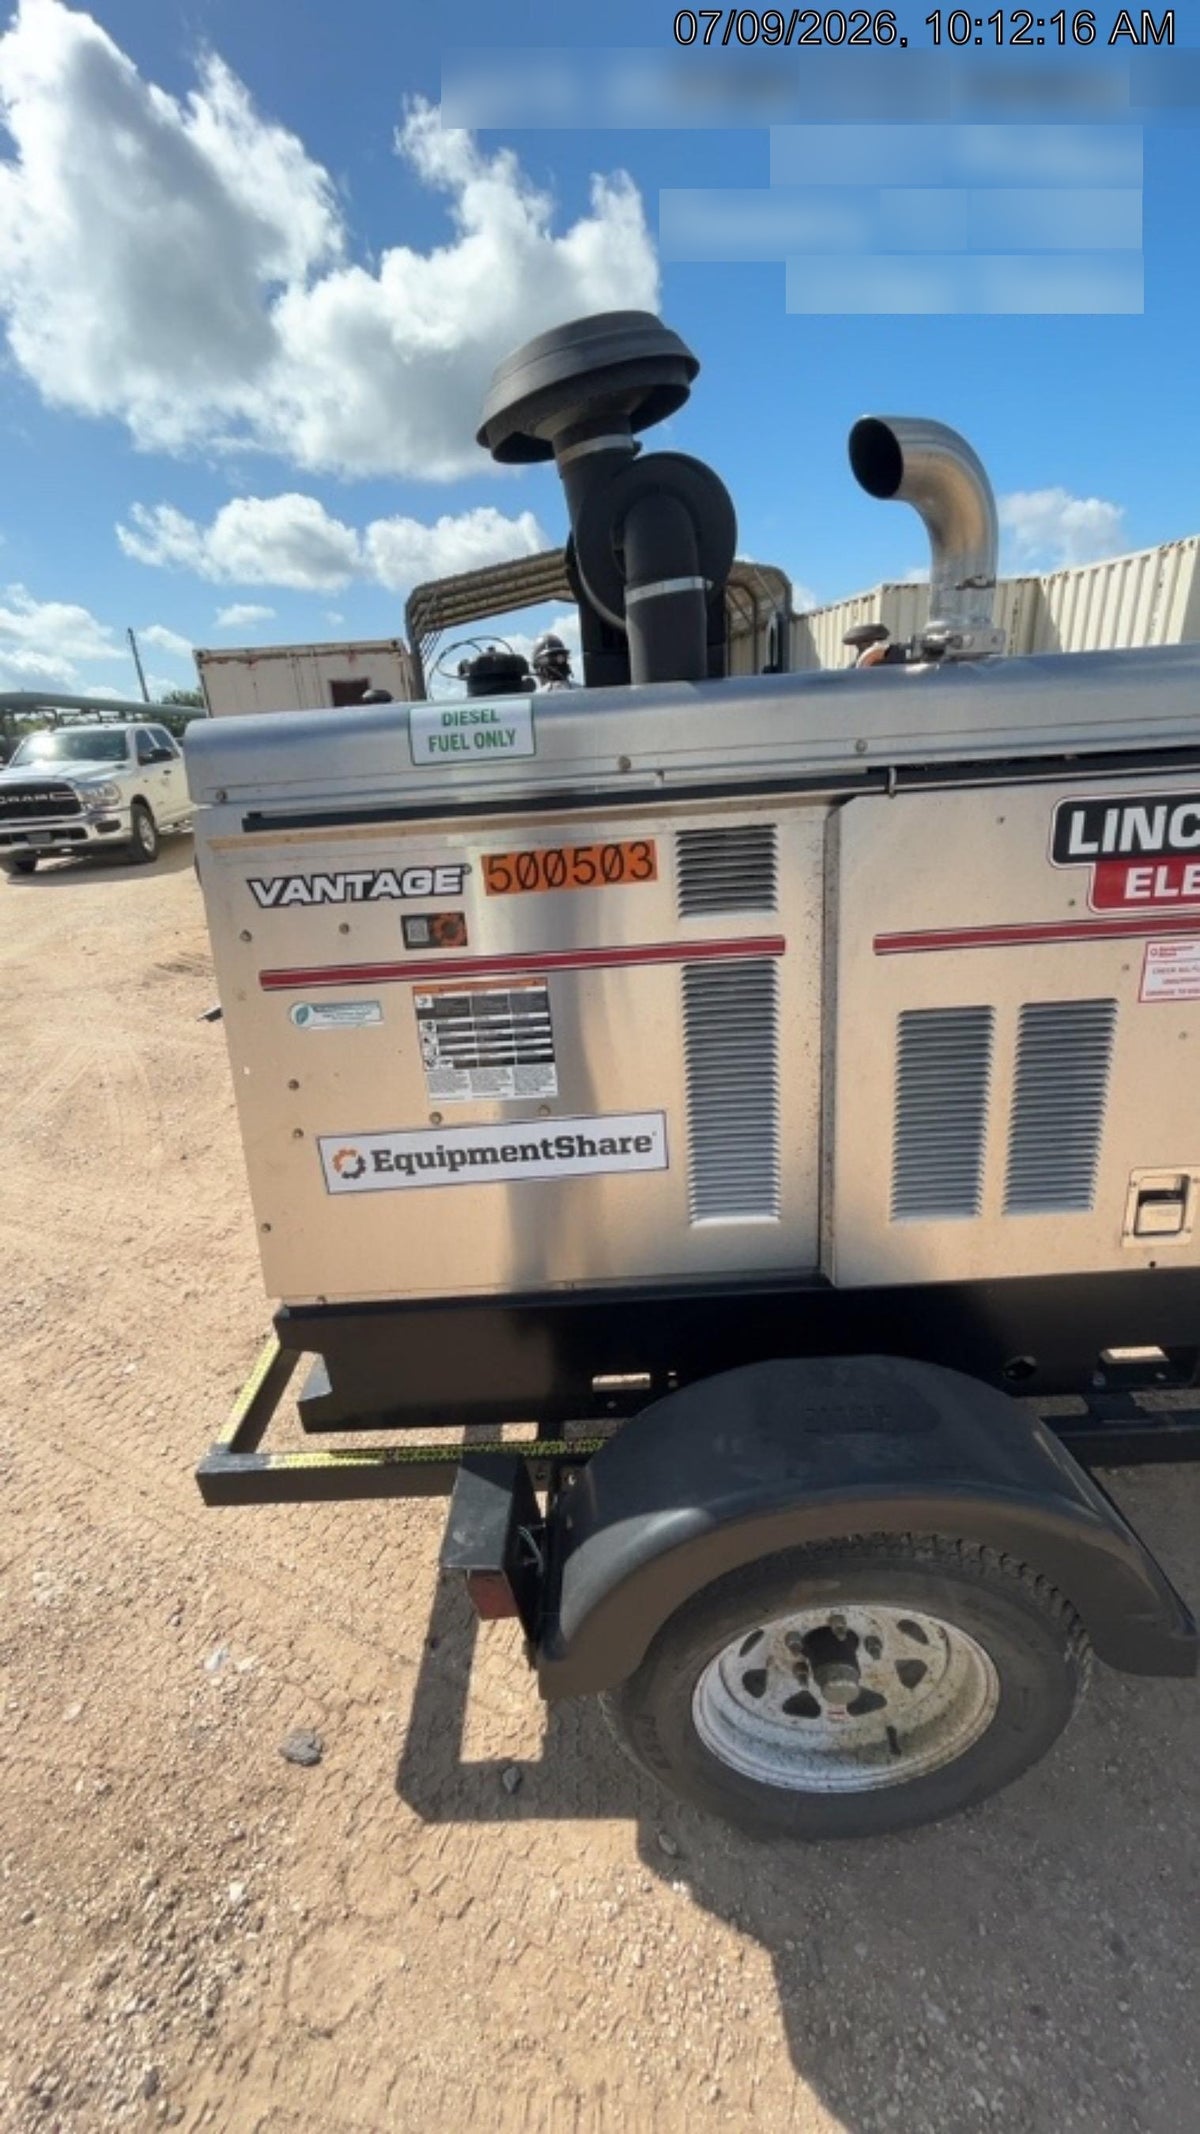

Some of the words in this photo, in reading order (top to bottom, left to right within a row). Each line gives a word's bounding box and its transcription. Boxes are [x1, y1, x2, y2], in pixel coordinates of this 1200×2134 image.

[441, 708, 500, 727] DIESEL
[428, 733, 470, 753] FUEL
[473, 727, 516, 750] ONLY
[247, 864, 464, 908] VANTAGE
[486, 840, 654, 894] 500503
[371, 1135, 653, 1174] EquipmentShare
